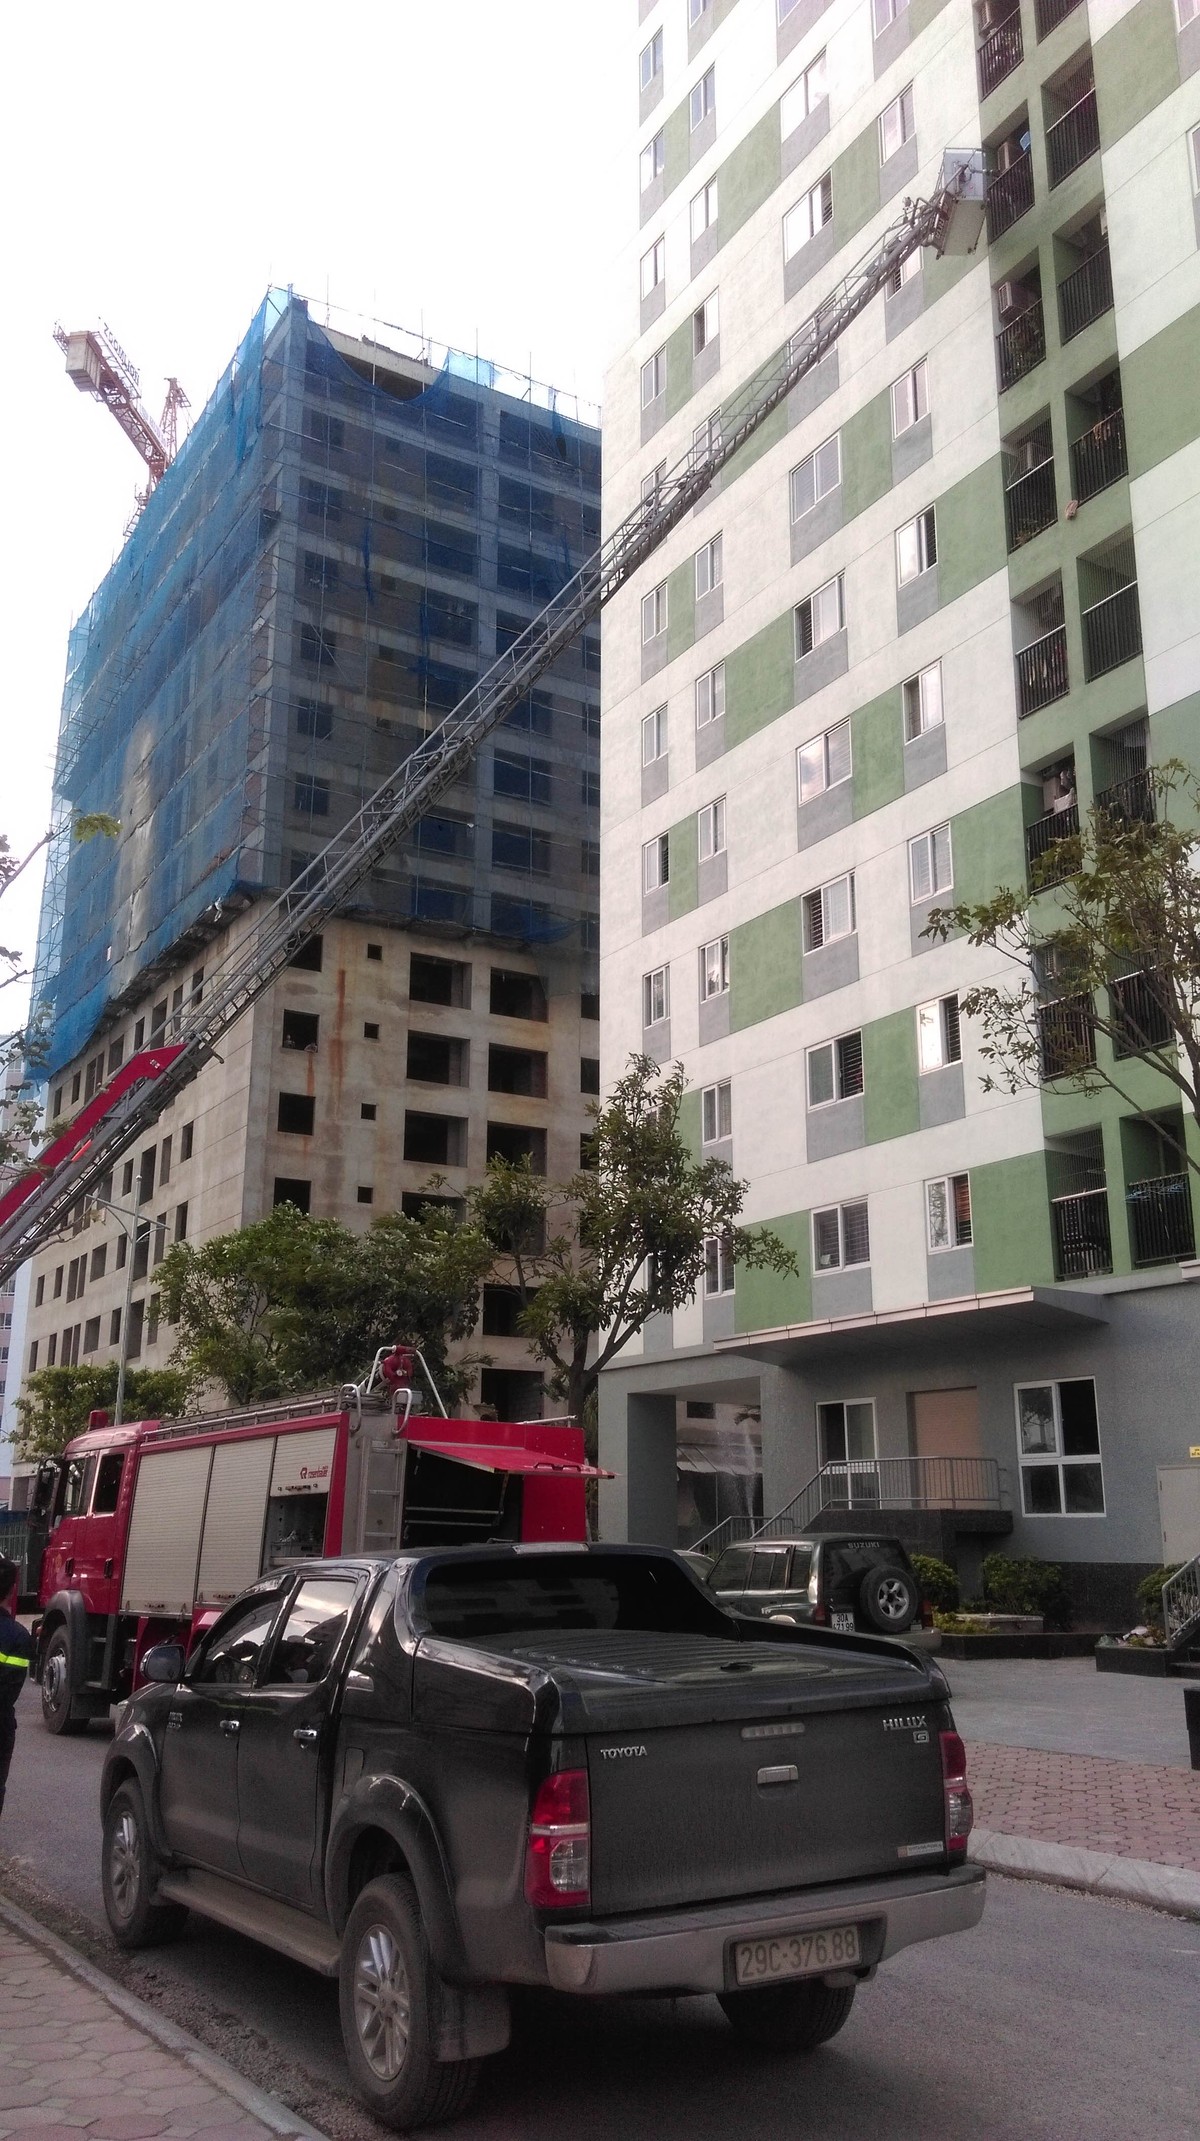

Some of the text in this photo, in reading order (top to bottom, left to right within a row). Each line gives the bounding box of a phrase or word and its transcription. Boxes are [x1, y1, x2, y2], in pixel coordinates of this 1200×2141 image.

[847, 1541, 880, 1549] SUZUKI
[836, 1613, 849, 1622] 30A
[882, 1715, 928, 1731] HILUX
[600, 1745, 648, 1760] TOYOTA
